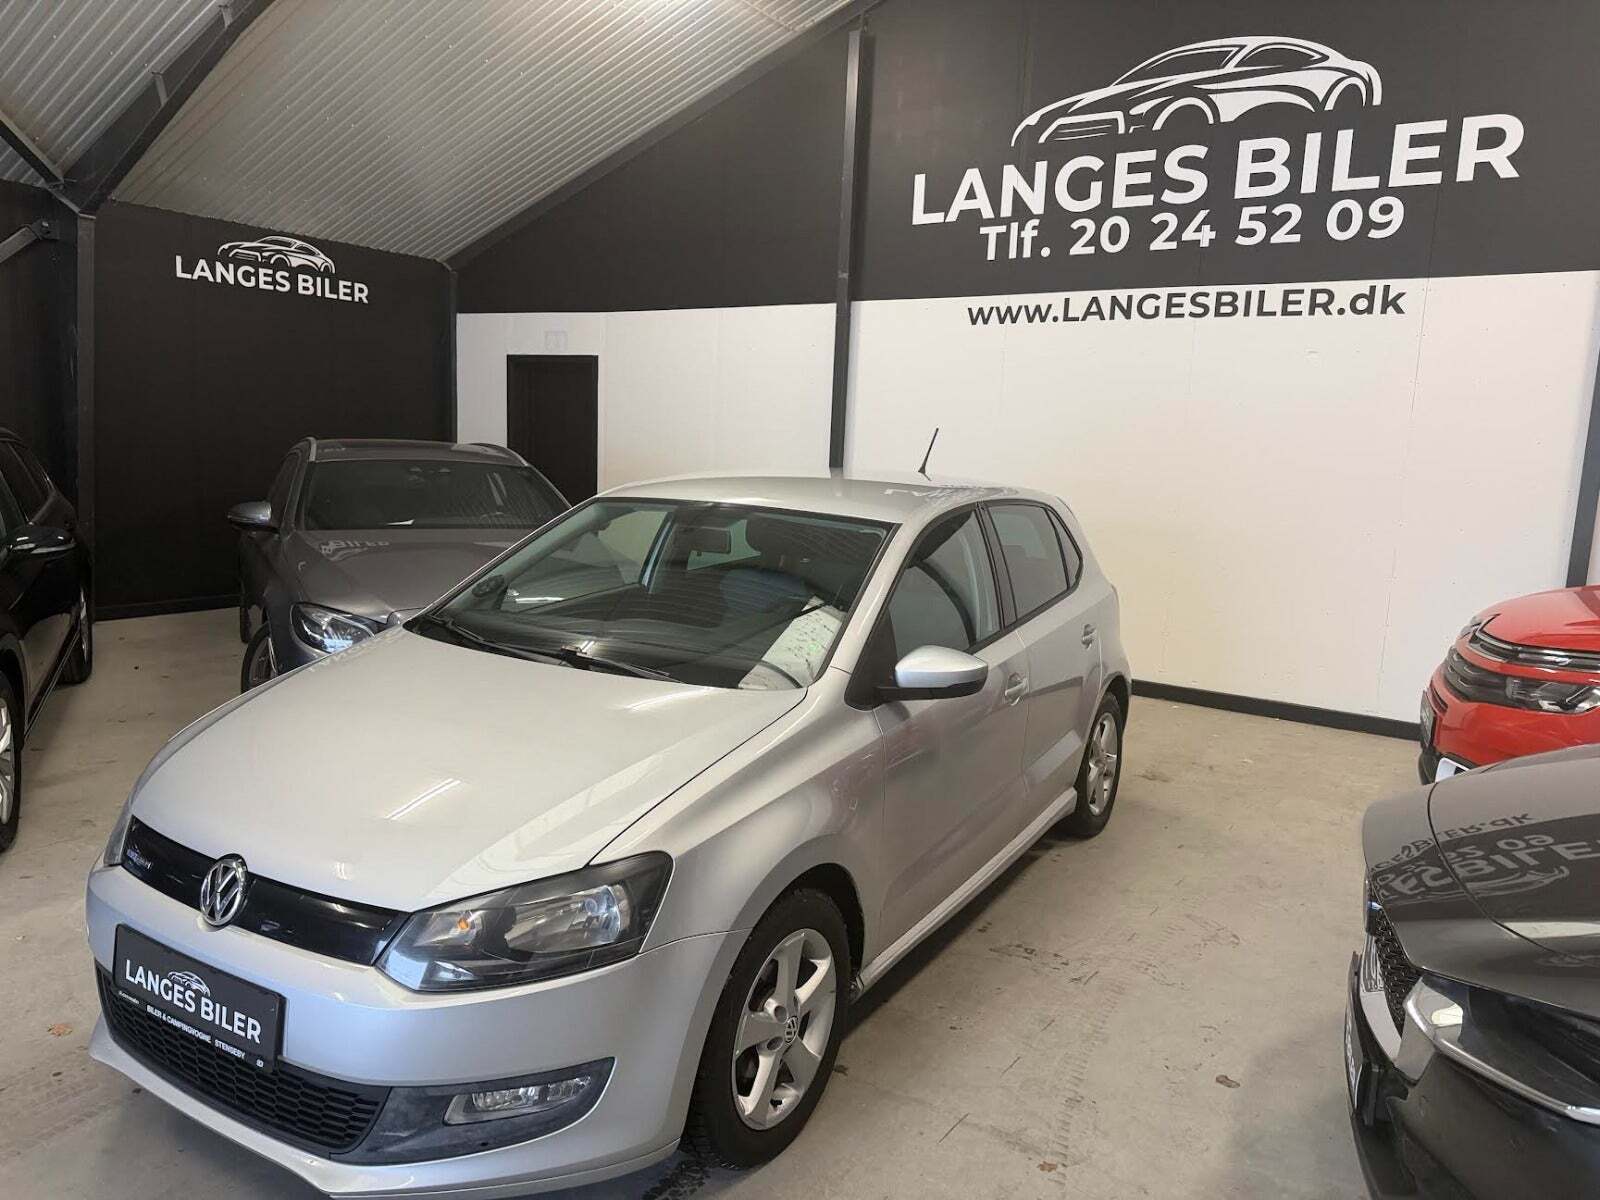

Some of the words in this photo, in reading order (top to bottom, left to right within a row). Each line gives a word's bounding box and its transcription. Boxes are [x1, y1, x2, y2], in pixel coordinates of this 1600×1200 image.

[911, 144, 1209, 226] LANGES
[1233, 113, 1525, 200] BILER
[979, 218, 1051, 261] Tlf.
[1069, 215, 1130, 256] 20
[1149, 209, 1217, 251] 24
[1234, 203, 1303, 246] 52
[1326, 195, 1405, 241] 09
[175, 255, 291, 293] LANGES
[297, 273, 369, 304] BILER
[967, 284, 1406, 326] www.LANGESBILER.dk
[125, 959, 196, 1013] LANGES
[200, 996, 262, 1044] BILER
